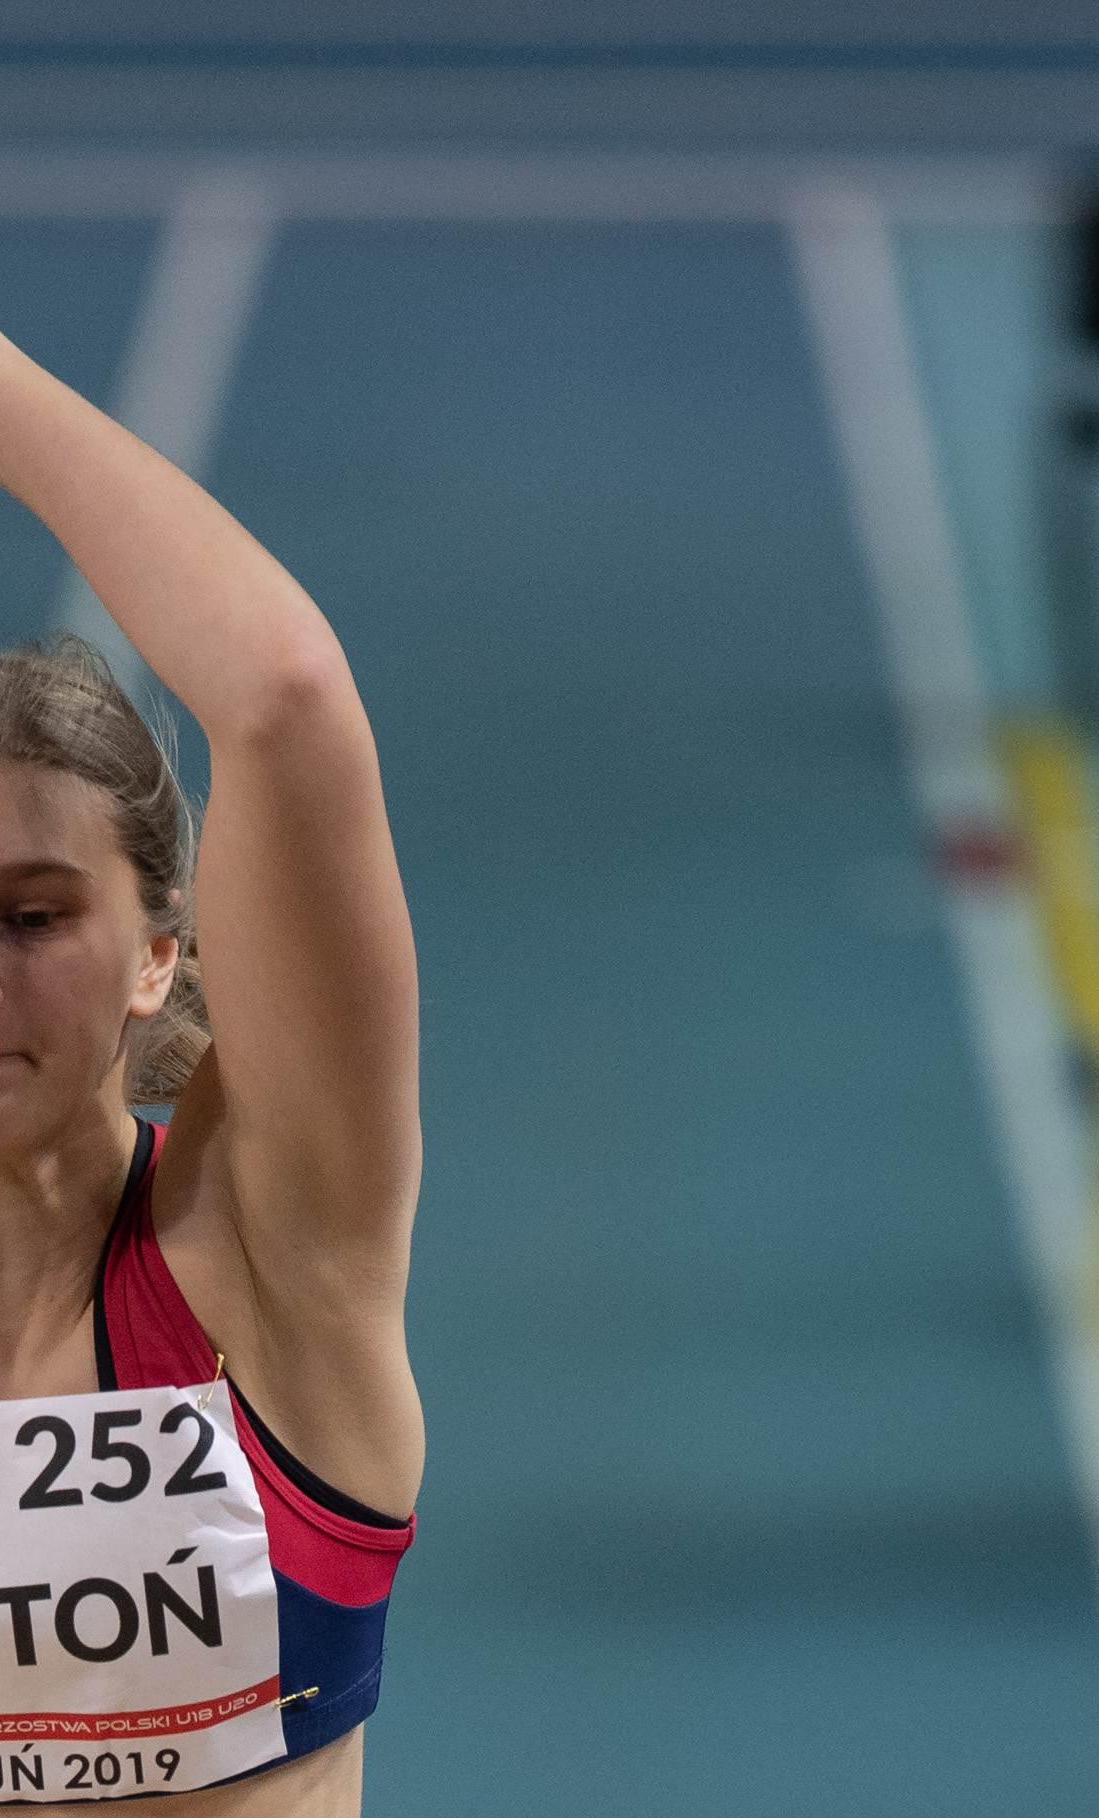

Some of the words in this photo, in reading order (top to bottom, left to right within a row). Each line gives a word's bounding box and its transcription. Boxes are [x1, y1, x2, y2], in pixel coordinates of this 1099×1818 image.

[14, 1402, 227, 1510] 252
[95, 1714, 171, 1733] POLSKI
[175, 1708, 213, 1726] U18
[218, 1692, 258, 1715] U20
[63, 1748, 181, 1790] 2019
